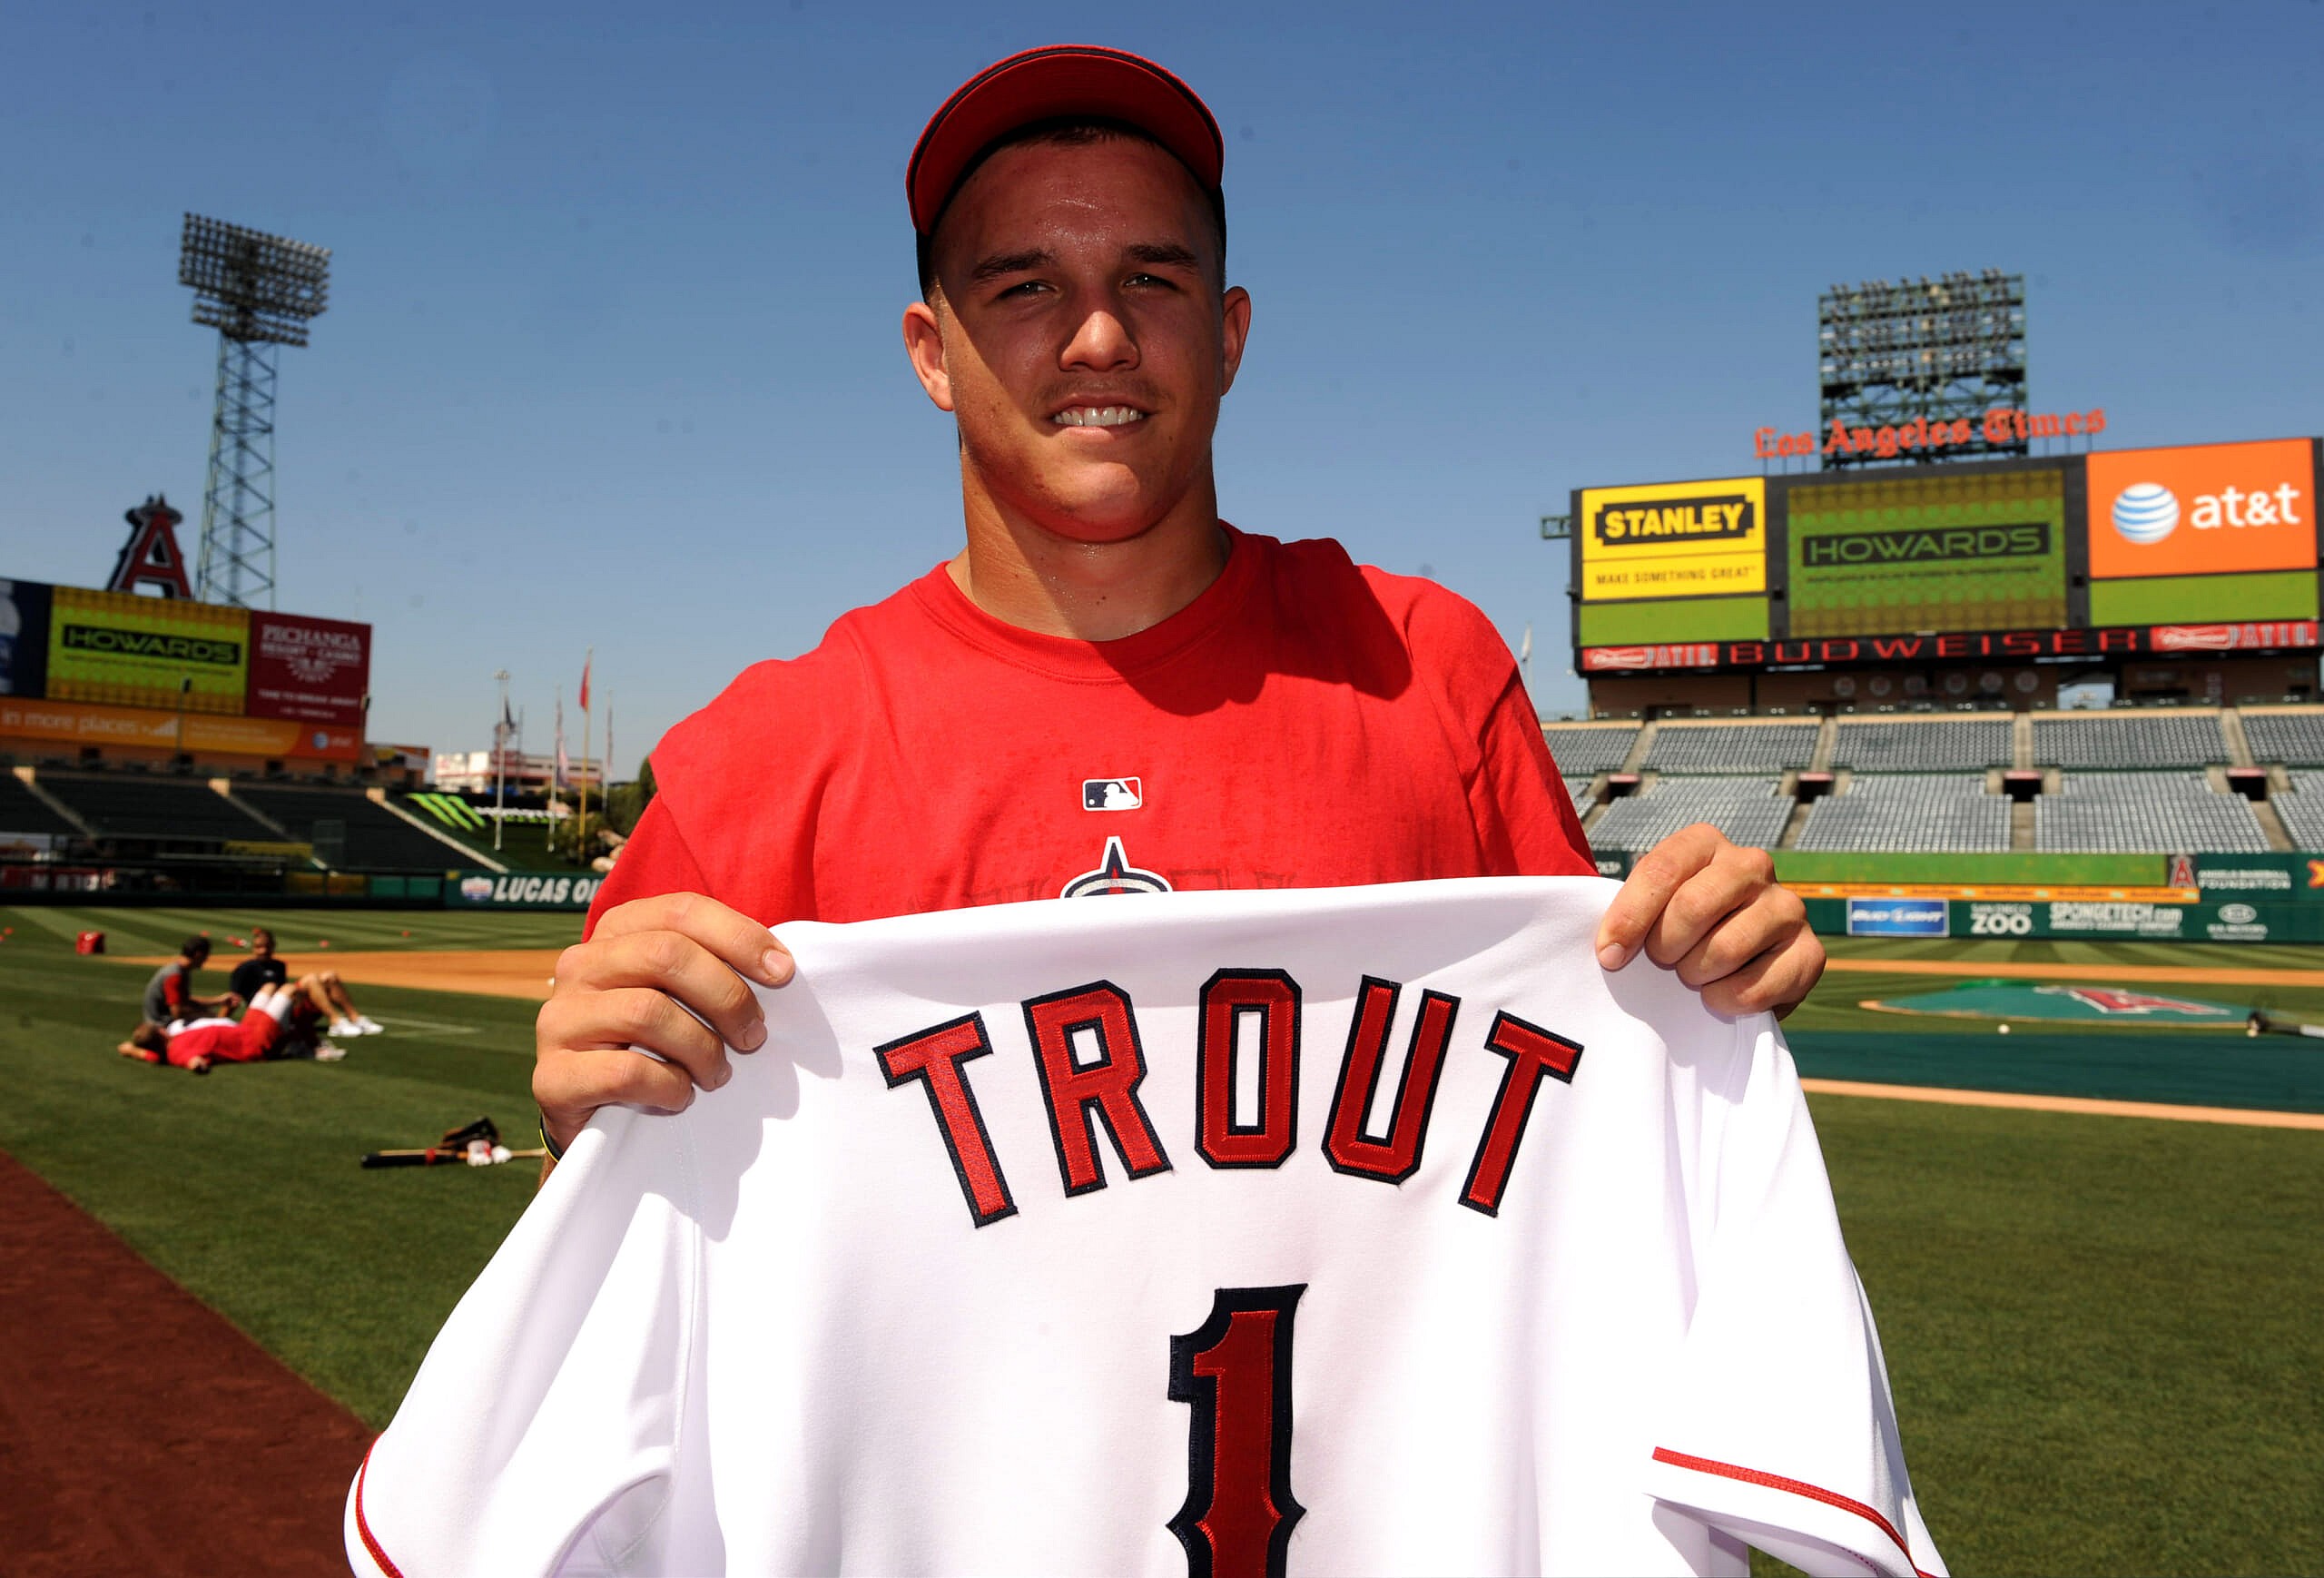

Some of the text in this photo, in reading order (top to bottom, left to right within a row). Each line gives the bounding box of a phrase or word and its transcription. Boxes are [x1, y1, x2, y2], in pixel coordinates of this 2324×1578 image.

[1754, 407, 2107, 459] Los Angeles Times
[1604, 503, 1745, 539] STANLEY
[2190, 482, 2301, 529] at&t
[1596, 572, 1630, 586] MAKE
[1634, 569, 1706, 584] SOMETHING
[1729, 629, 2138, 665] BUDWEISER
[493, 876, 571, 902] LUCAS
[1970, 913, 2033, 935] ZOO
[875, 967, 1585, 1228] TROUT
[1166, 1283, 1308, 1578] 1
